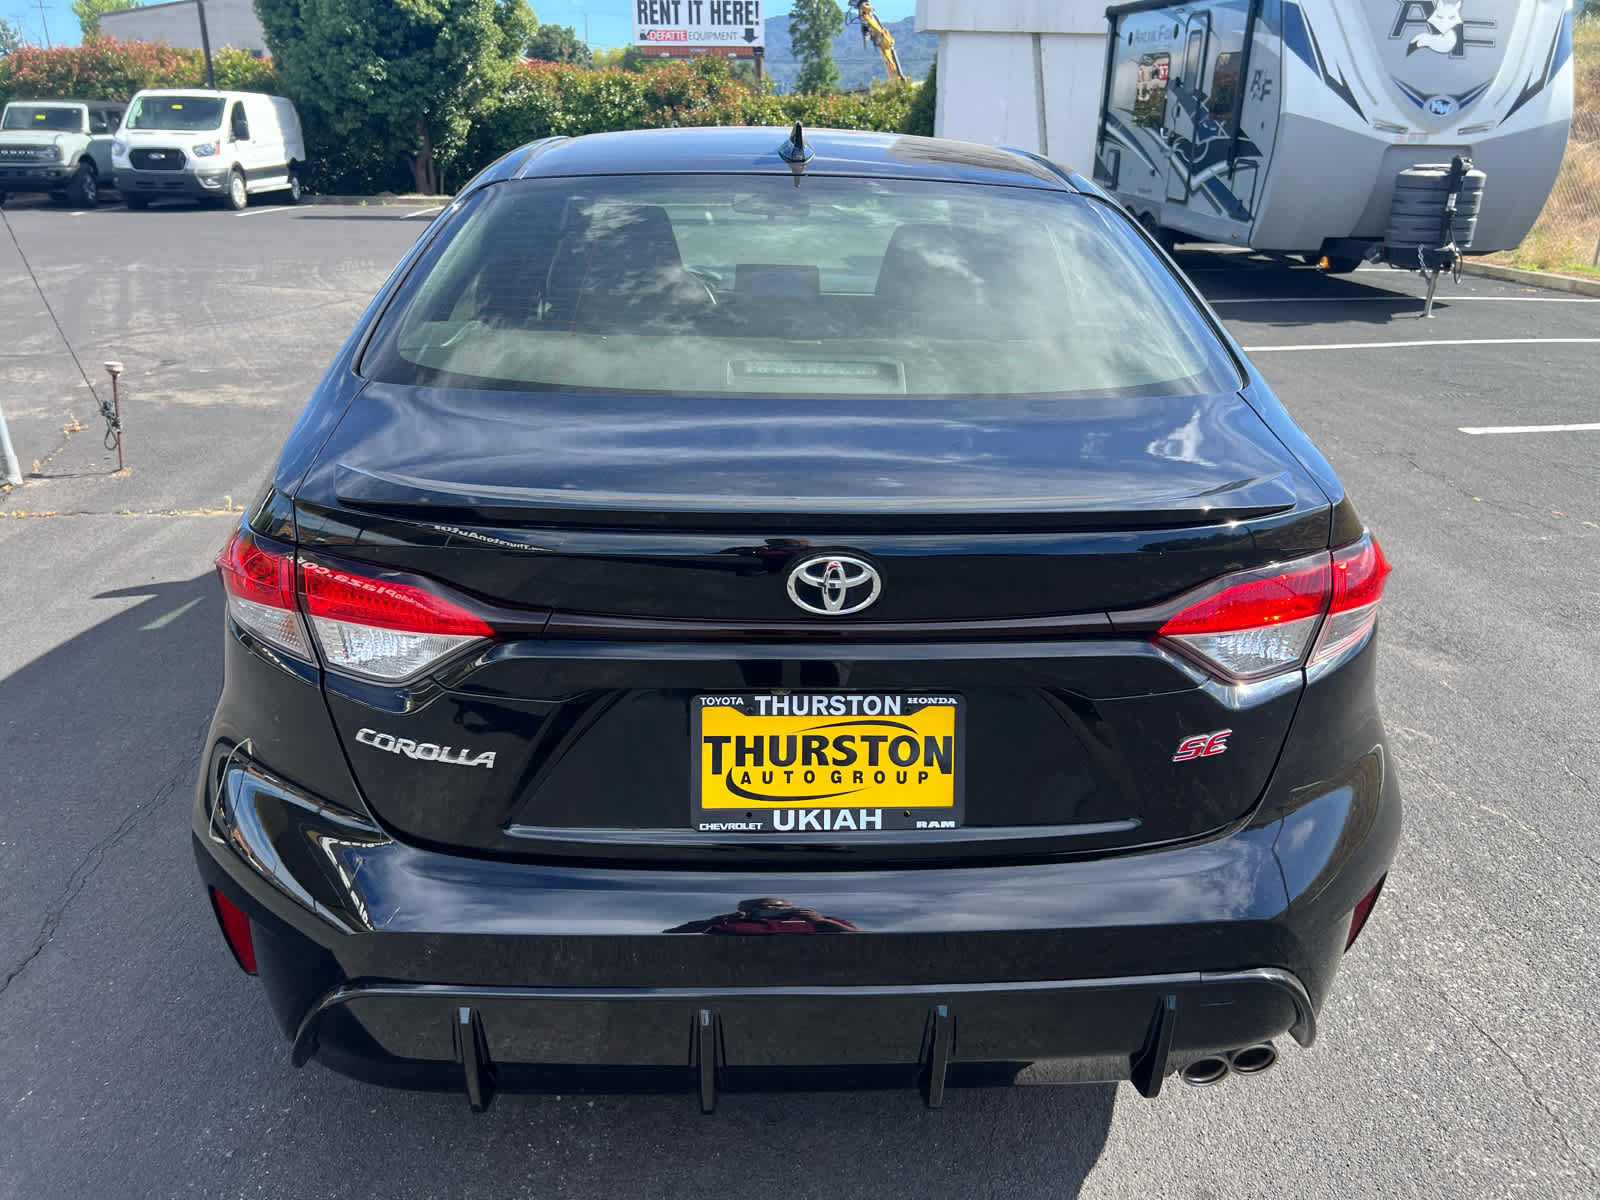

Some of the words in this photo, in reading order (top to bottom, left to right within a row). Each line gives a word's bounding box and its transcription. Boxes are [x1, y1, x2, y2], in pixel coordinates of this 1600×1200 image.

[637, 0, 681, 25] RENT
[688, 0, 703, 25] IT
[710, 0, 760, 25] HERE!
[688, 31, 738, 41] EQUIPMENT
[700, 697, 744, 706] TOYOTA
[754, 695, 901, 716] THURSTON
[907, 697, 958, 705] HONDA
[355, 727, 497, 769] COROLLA
[1172, 728, 1233, 762] SE
[703, 735, 953, 775] THURSTON
[740, 770, 816, 784] AUTO
[830, 770, 929, 784] GROUP
[699, 822, 764, 831] CHEVROLET
[772, 808, 882, 831] UKIAH
[916, 820, 955, 829] RAM
